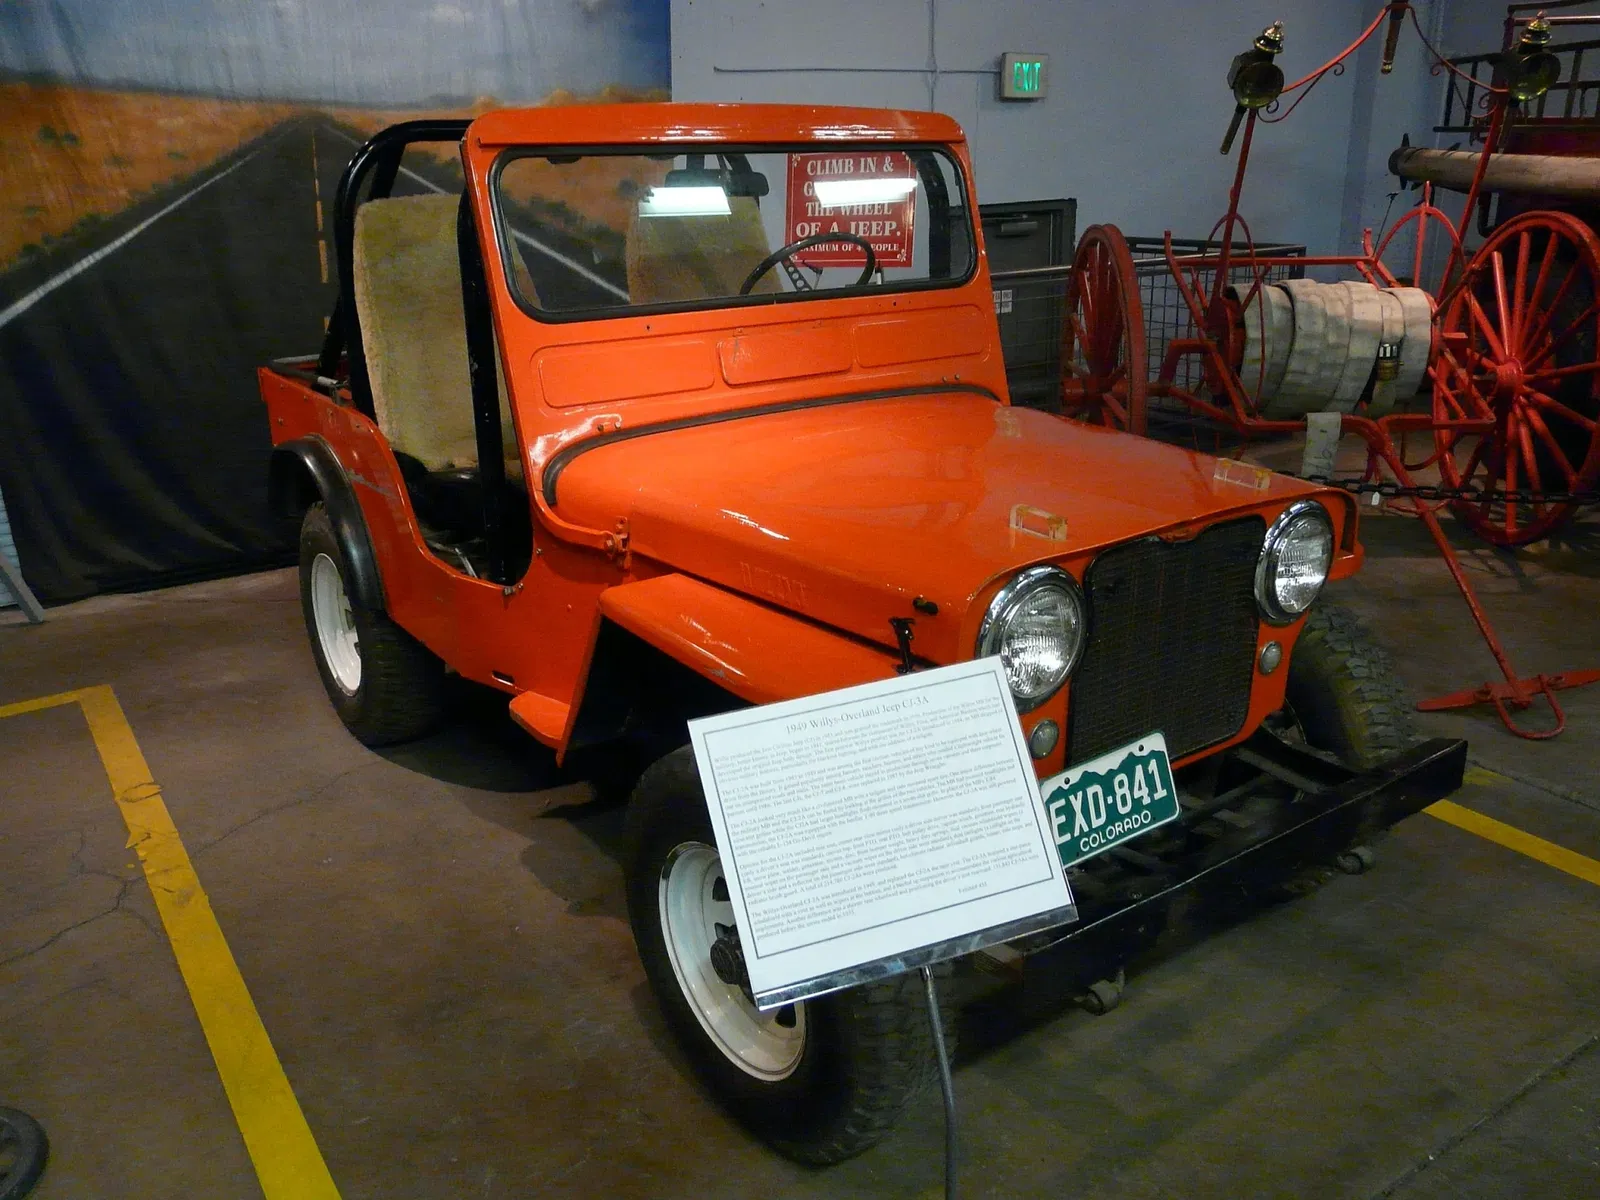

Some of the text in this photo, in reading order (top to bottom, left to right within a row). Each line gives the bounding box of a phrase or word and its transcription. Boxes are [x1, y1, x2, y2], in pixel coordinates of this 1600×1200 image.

[1013, 62, 1041, 92] EXIT
[807, 155, 894, 176] CLIMB IN &
[806, 201, 893, 217] THE WHEEL
[796, 222, 822, 238] OF
[830, 221, 840, 233] A
[841, 243, 855, 252] OF
[870, 243, 900, 252] EOPLE
[786, 722, 807, 735] 1949
[810, 709, 881, 728] Willys-Overland
[882, 702, 901, 714] Jeep
[1079, 810, 1152, 852] COLORADO
